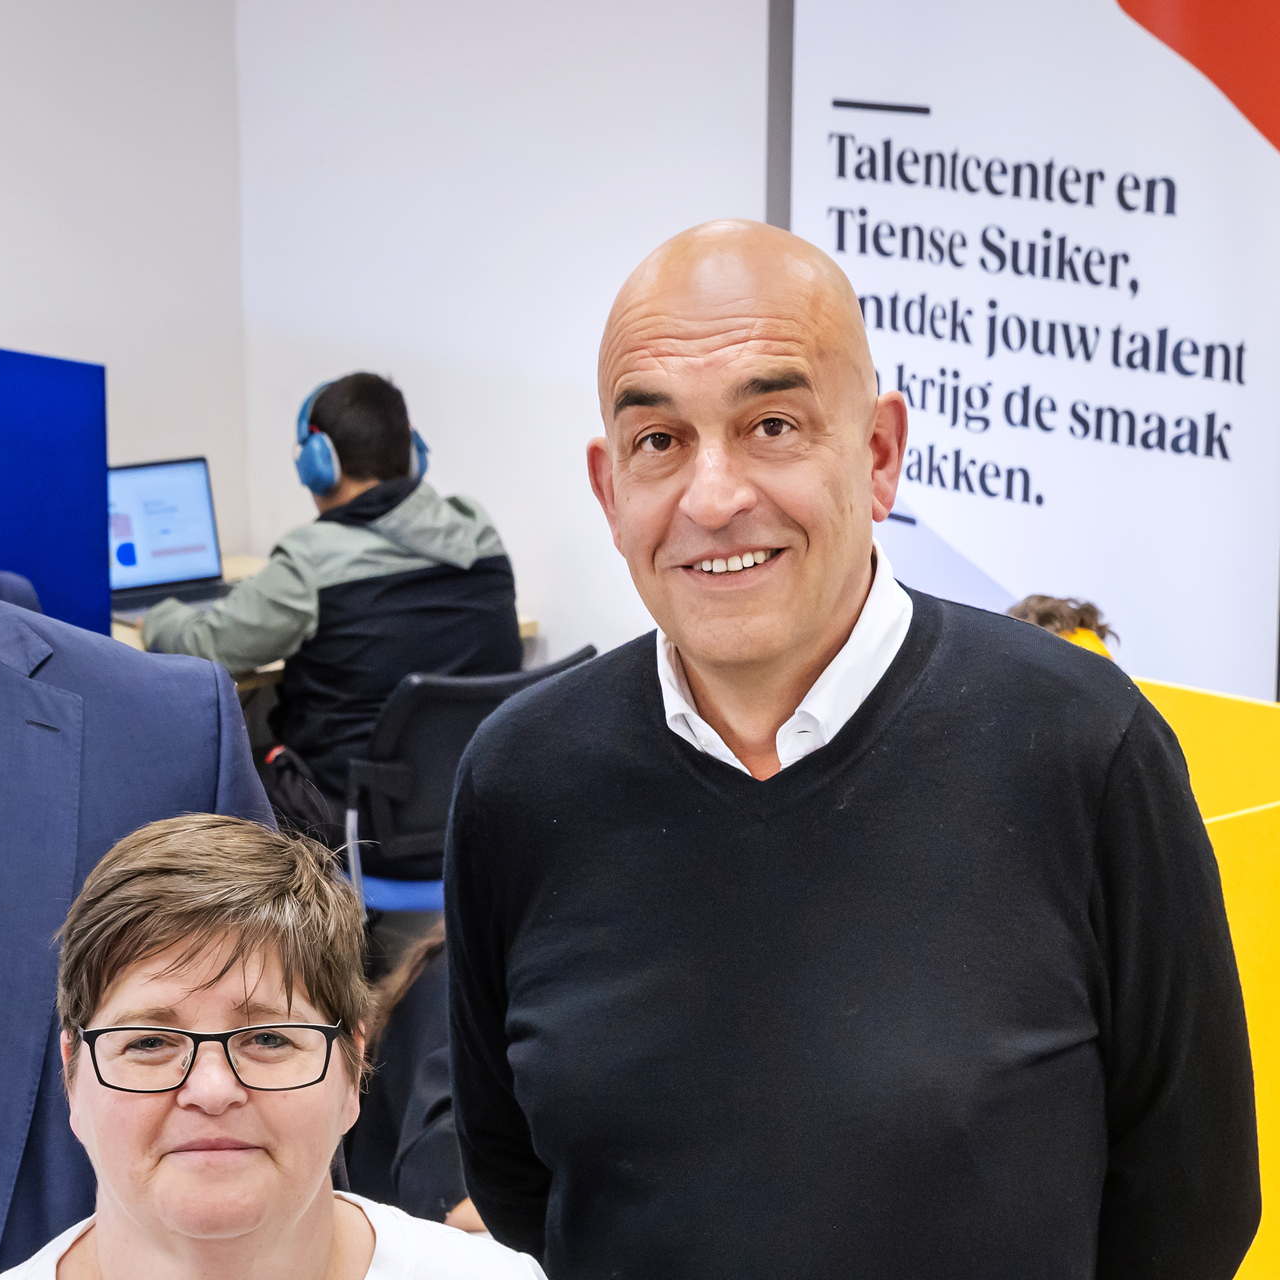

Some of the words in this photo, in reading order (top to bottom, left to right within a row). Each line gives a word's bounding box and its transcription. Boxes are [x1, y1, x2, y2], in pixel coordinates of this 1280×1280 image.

[828, 132, 1106, 208] Talentcenter
[1115, 173, 1178, 216] en
[828, 206, 968, 268] Tiense
[979, 226, 1140, 298] Suiker,
[857, 291, 974, 346] ntdek
[985, 299, 1100, 363] jouw
[1111, 324, 1248, 387] talent
[896, 363, 992, 433] krijg
[1003, 383, 1058, 433] de
[1069, 402, 1234, 462] smaak
[905, 444, 1045, 507] akken.
